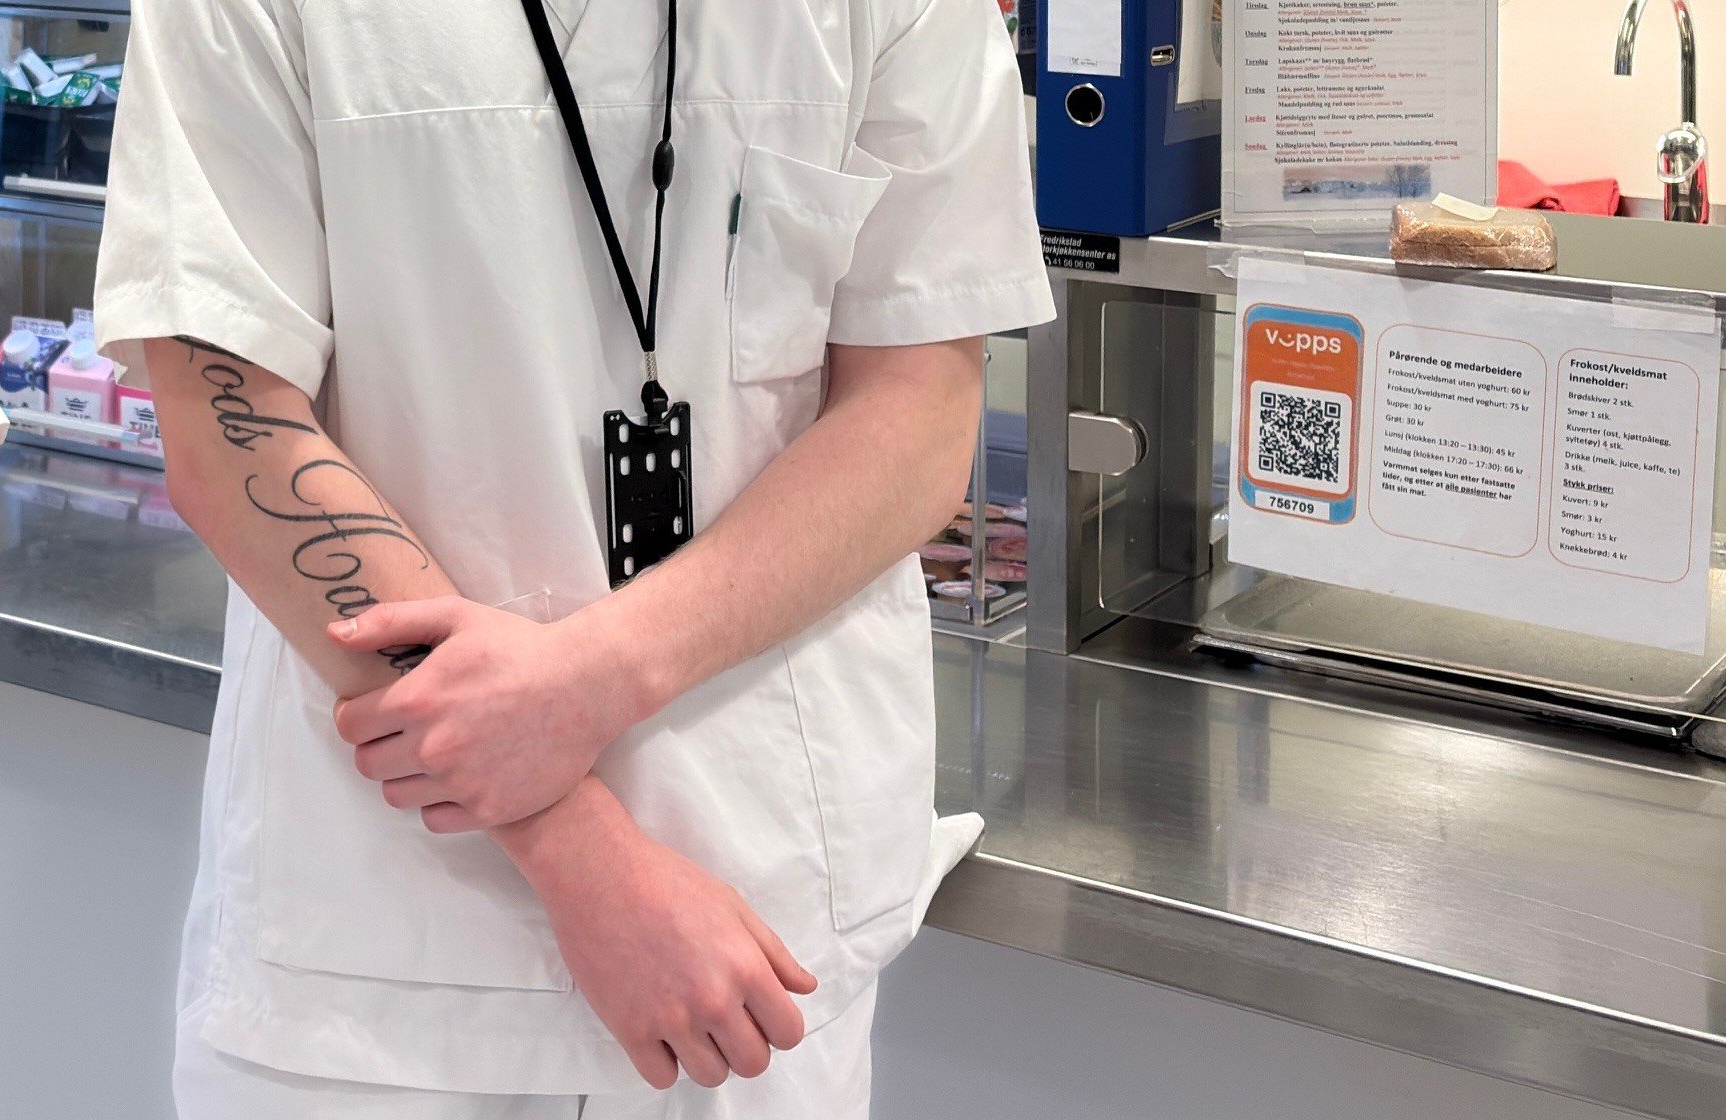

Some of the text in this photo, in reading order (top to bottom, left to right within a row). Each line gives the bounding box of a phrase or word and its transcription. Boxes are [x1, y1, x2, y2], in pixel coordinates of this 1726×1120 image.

[1042, 246, 1105, 259] torkjøkkensenter
[1265, 328, 1341, 355] vipps
[1389, 350, 1522, 378] Pårørende og medarbeidere
[1570, 359, 1667, 380] Frokost/kveldsmat
[1388, 368, 1456, 385] Frokost/kveldsmat
[1459, 379, 1475, 387] uten
[1477, 382, 1509, 393] yoghurt:
[1523, 388, 1530, 396] kr
[171, 334, 320, 452] ods
[1387, 384, 1455, 400] Frokost/kveldsmat
[1457, 394, 1474, 403] med
[1476, 398, 1507, 409] yoghurt:
[1510, 402, 1520, 410] 75
[1568, 392, 1611, 404] Brødskiver
[1386, 399, 1411, 409] Suppe:
[1413, 403, 1422, 411] 30
[1385, 414, 1404, 423] Grøt:
[1567, 408, 1588, 417] Smør
[1598, 413, 1611, 421] stk.
[1566, 424, 1601, 435] Kuverter
[1384, 430, 1515, 458] Lunsj (klokken 13:20 13:30): 45 kr
[1566, 436, 1600, 447] syltetøy)
[1384, 445, 1411, 457] Middag
[1413, 450, 1444, 461] (klokken
[1447, 455, 1467, 465] 17:20
[1476, 460, 1502, 472] 17:30):
[1516, 467, 1523, 475] kr
[1565, 451, 1681, 476] Drikke (melk, juice, kaffe, te)
[1383, 460, 1515, 490] Varmmat selges kun etter fastsatte
[1571, 464, 1585, 473] stk.
[1382, 472, 1402, 483] tider,
[1415, 477, 1434, 487] etter
[1445, 483, 1459, 492] alle
[1461, 486, 1498, 499] pasienter
[1499, 492, 1512, 501] har
[1382, 482, 1427, 497] fått sin mat.
[1563, 479, 1614, 495] Stykk priser:
[1269, 496, 1314, 514] 756709
[1563, 495, 1591, 506] Kuvert:
[1561, 511, 1585, 521] Smør:
[1561, 527, 1595, 539] Yoghurt:
[1598, 532, 1607, 540] 15
[1560, 543, 1609, 558] Knekkebrød:
